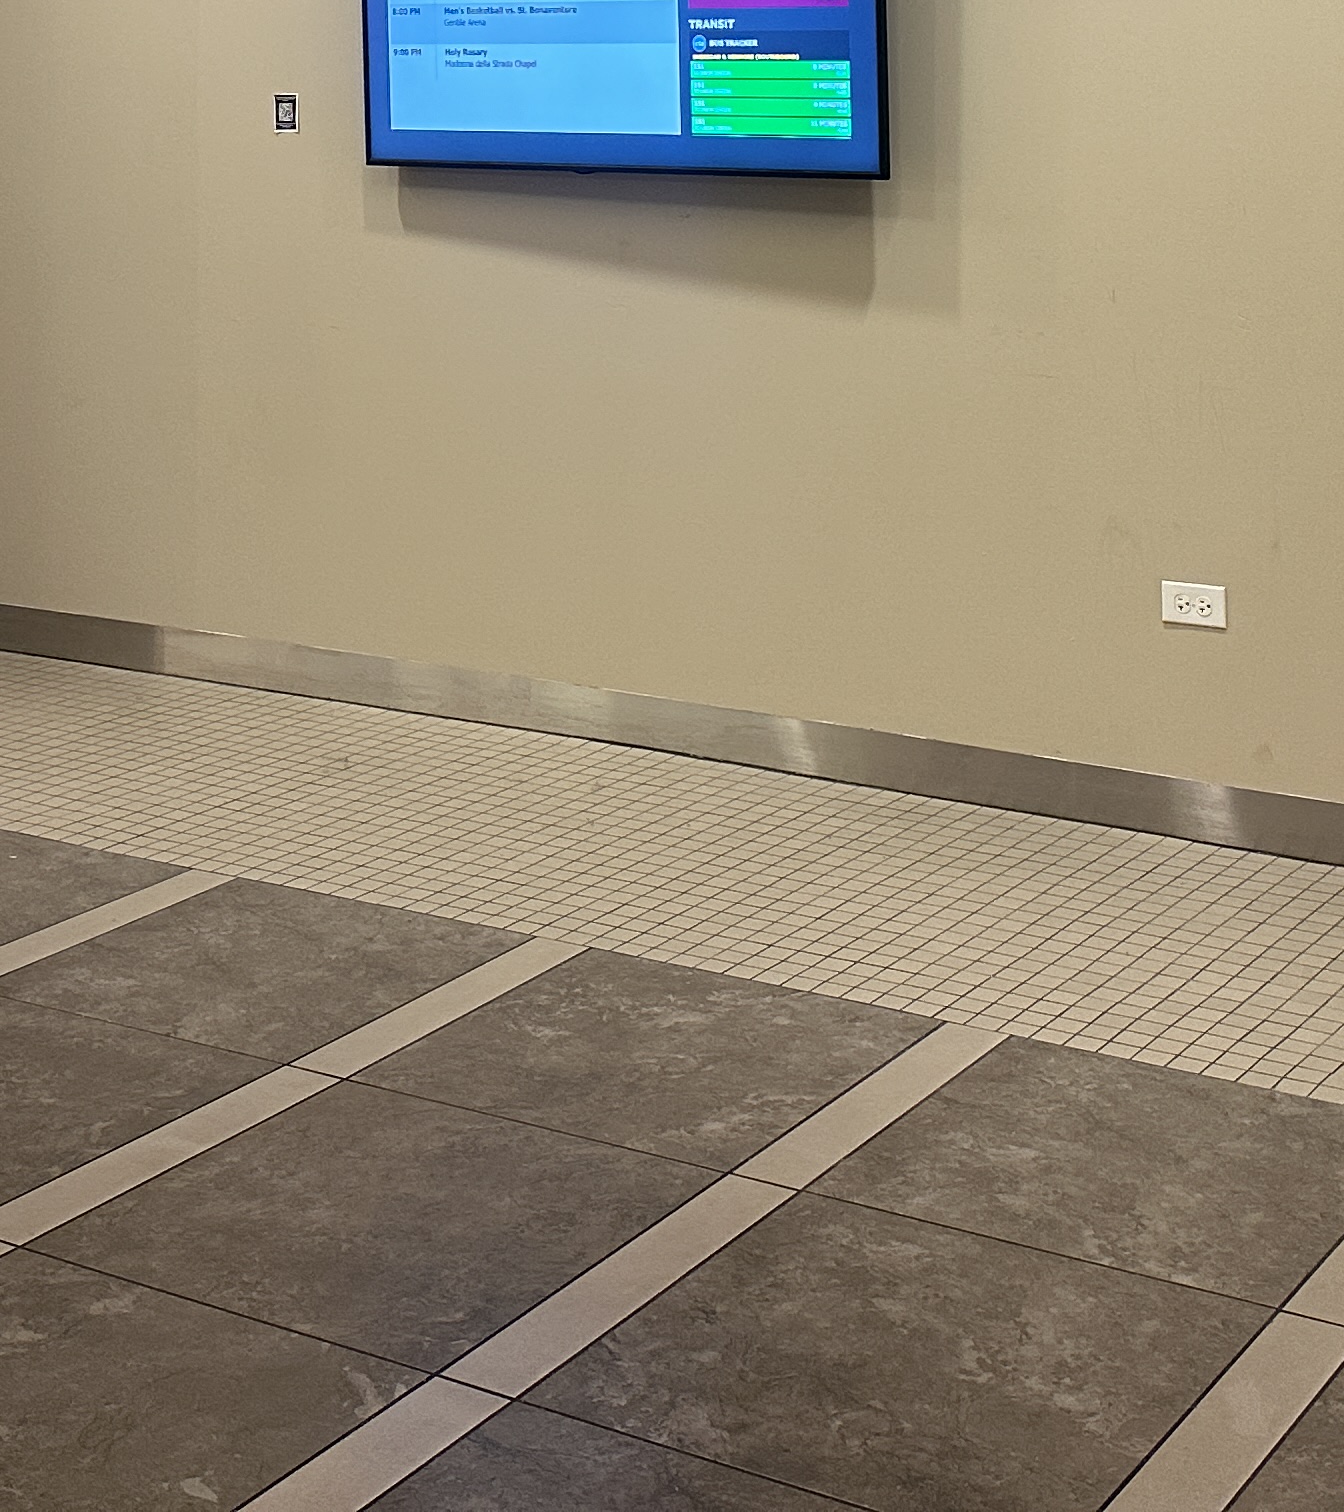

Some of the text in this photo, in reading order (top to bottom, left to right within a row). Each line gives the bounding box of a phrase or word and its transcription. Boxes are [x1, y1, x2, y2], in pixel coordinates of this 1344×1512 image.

[409, 8, 421, 16] PM
[688, 18, 735, 29] TRANSIT
[445, 48, 461, 58] Holy
